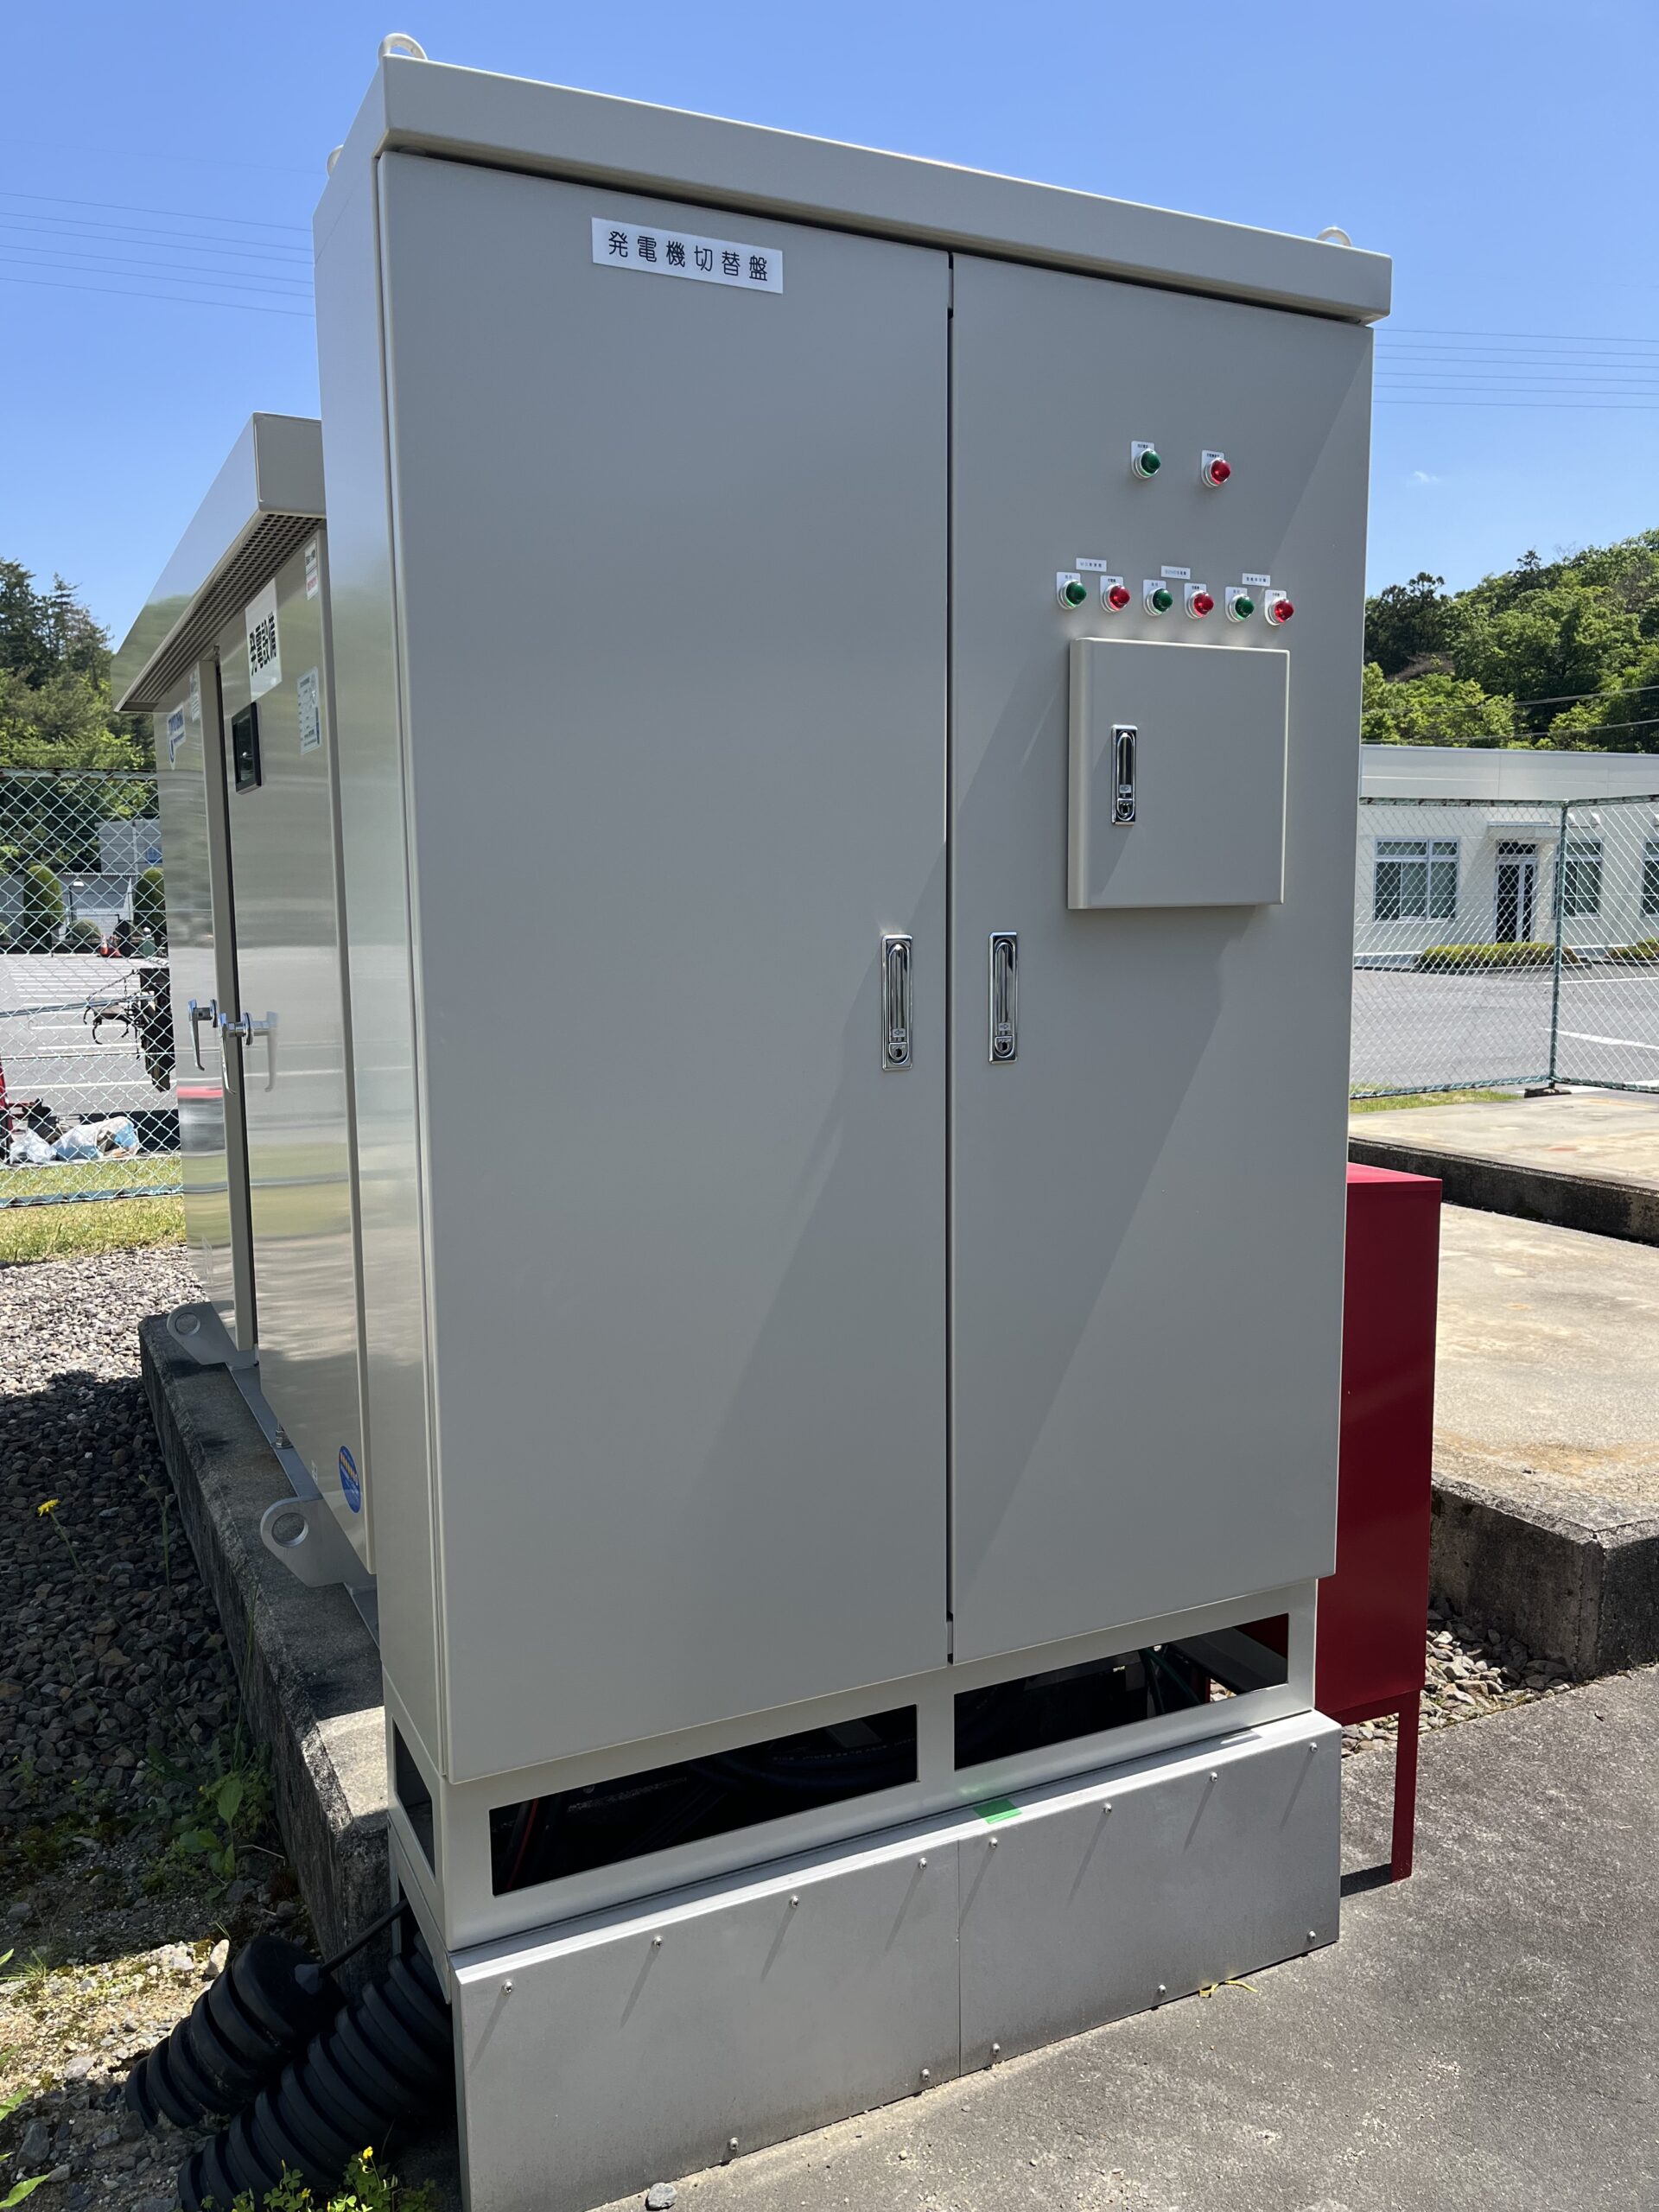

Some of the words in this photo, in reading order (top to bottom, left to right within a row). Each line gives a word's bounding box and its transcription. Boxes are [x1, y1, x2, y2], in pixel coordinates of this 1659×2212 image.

[608, 231, 768, 282] 発電機切替盤
[250, 611, 276, 677] 発電設備
